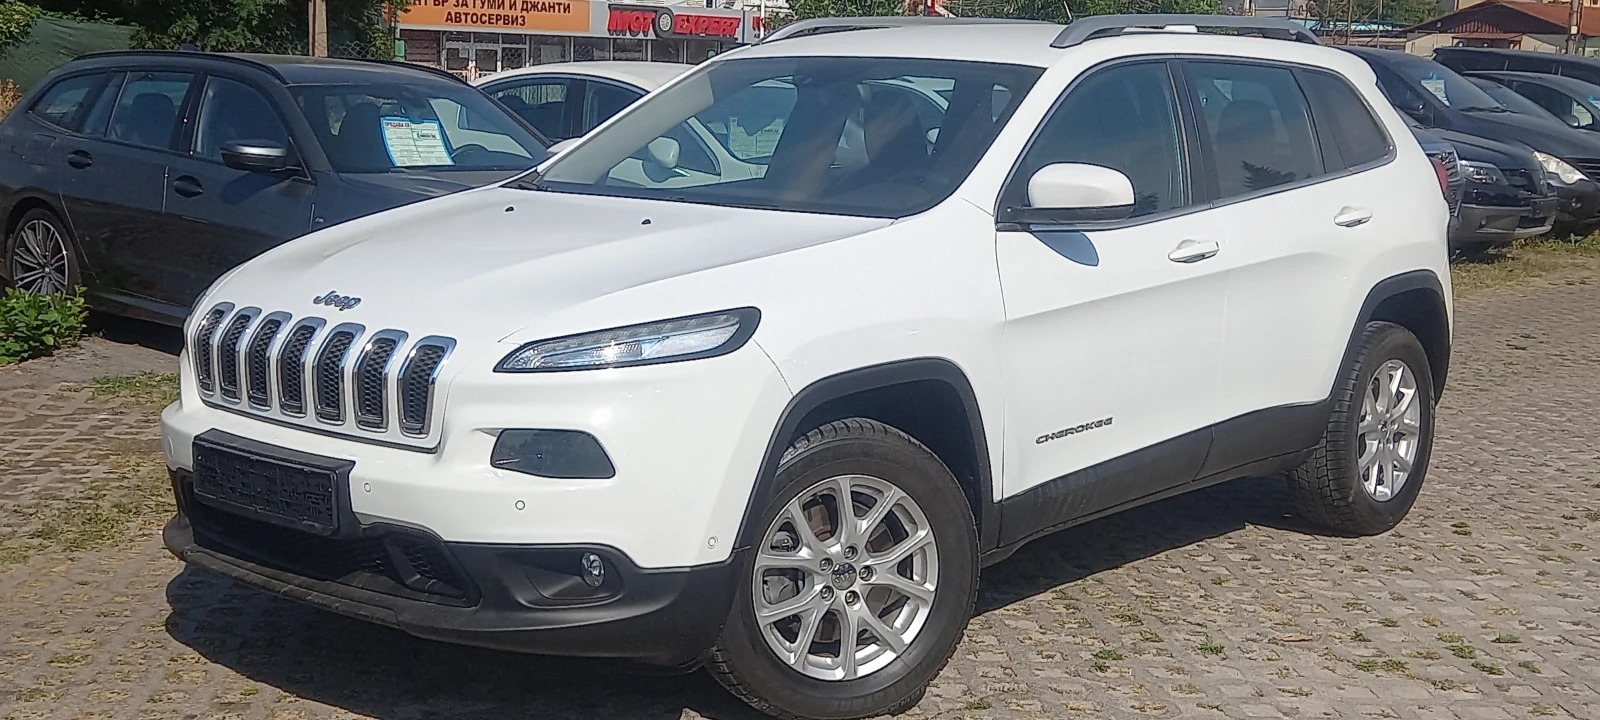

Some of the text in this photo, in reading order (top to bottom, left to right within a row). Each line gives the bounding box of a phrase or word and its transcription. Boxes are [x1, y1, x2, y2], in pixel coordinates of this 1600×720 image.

[453, 0, 469, 9] ЗА
[472, 0, 505, 11] ГУМИ
[509, 0, 517, 11] И
[520, 1, 571, 14] ДЖАНТИ
[445, 11, 526, 26] АВТОСЕРВИЗ
[673, 14, 741, 38] EXPERT
[313, 290, 362, 311] Jeep
[1035, 416, 1113, 445] CHEROKEE
